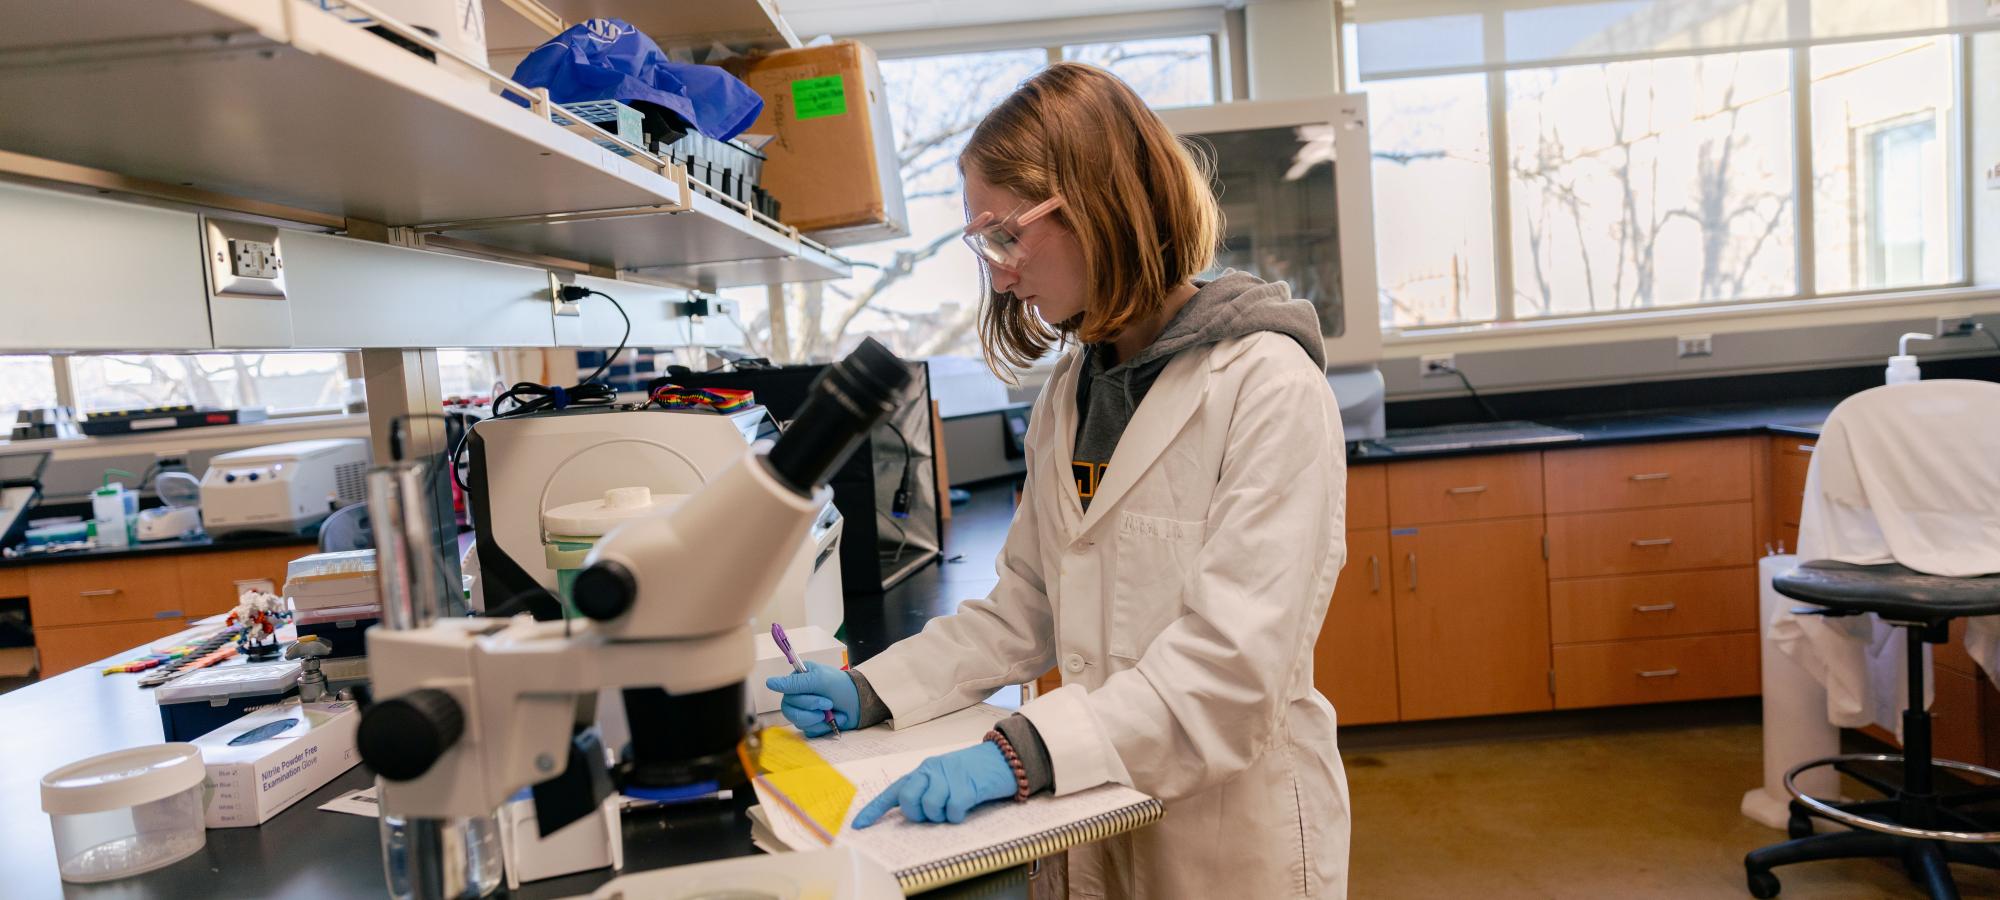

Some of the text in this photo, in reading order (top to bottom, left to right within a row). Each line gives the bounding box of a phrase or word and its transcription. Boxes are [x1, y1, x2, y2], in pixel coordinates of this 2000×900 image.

[261, 745, 318, 782] Nitrile Powder Free
[263, 756, 318, 792] Examination Glove
